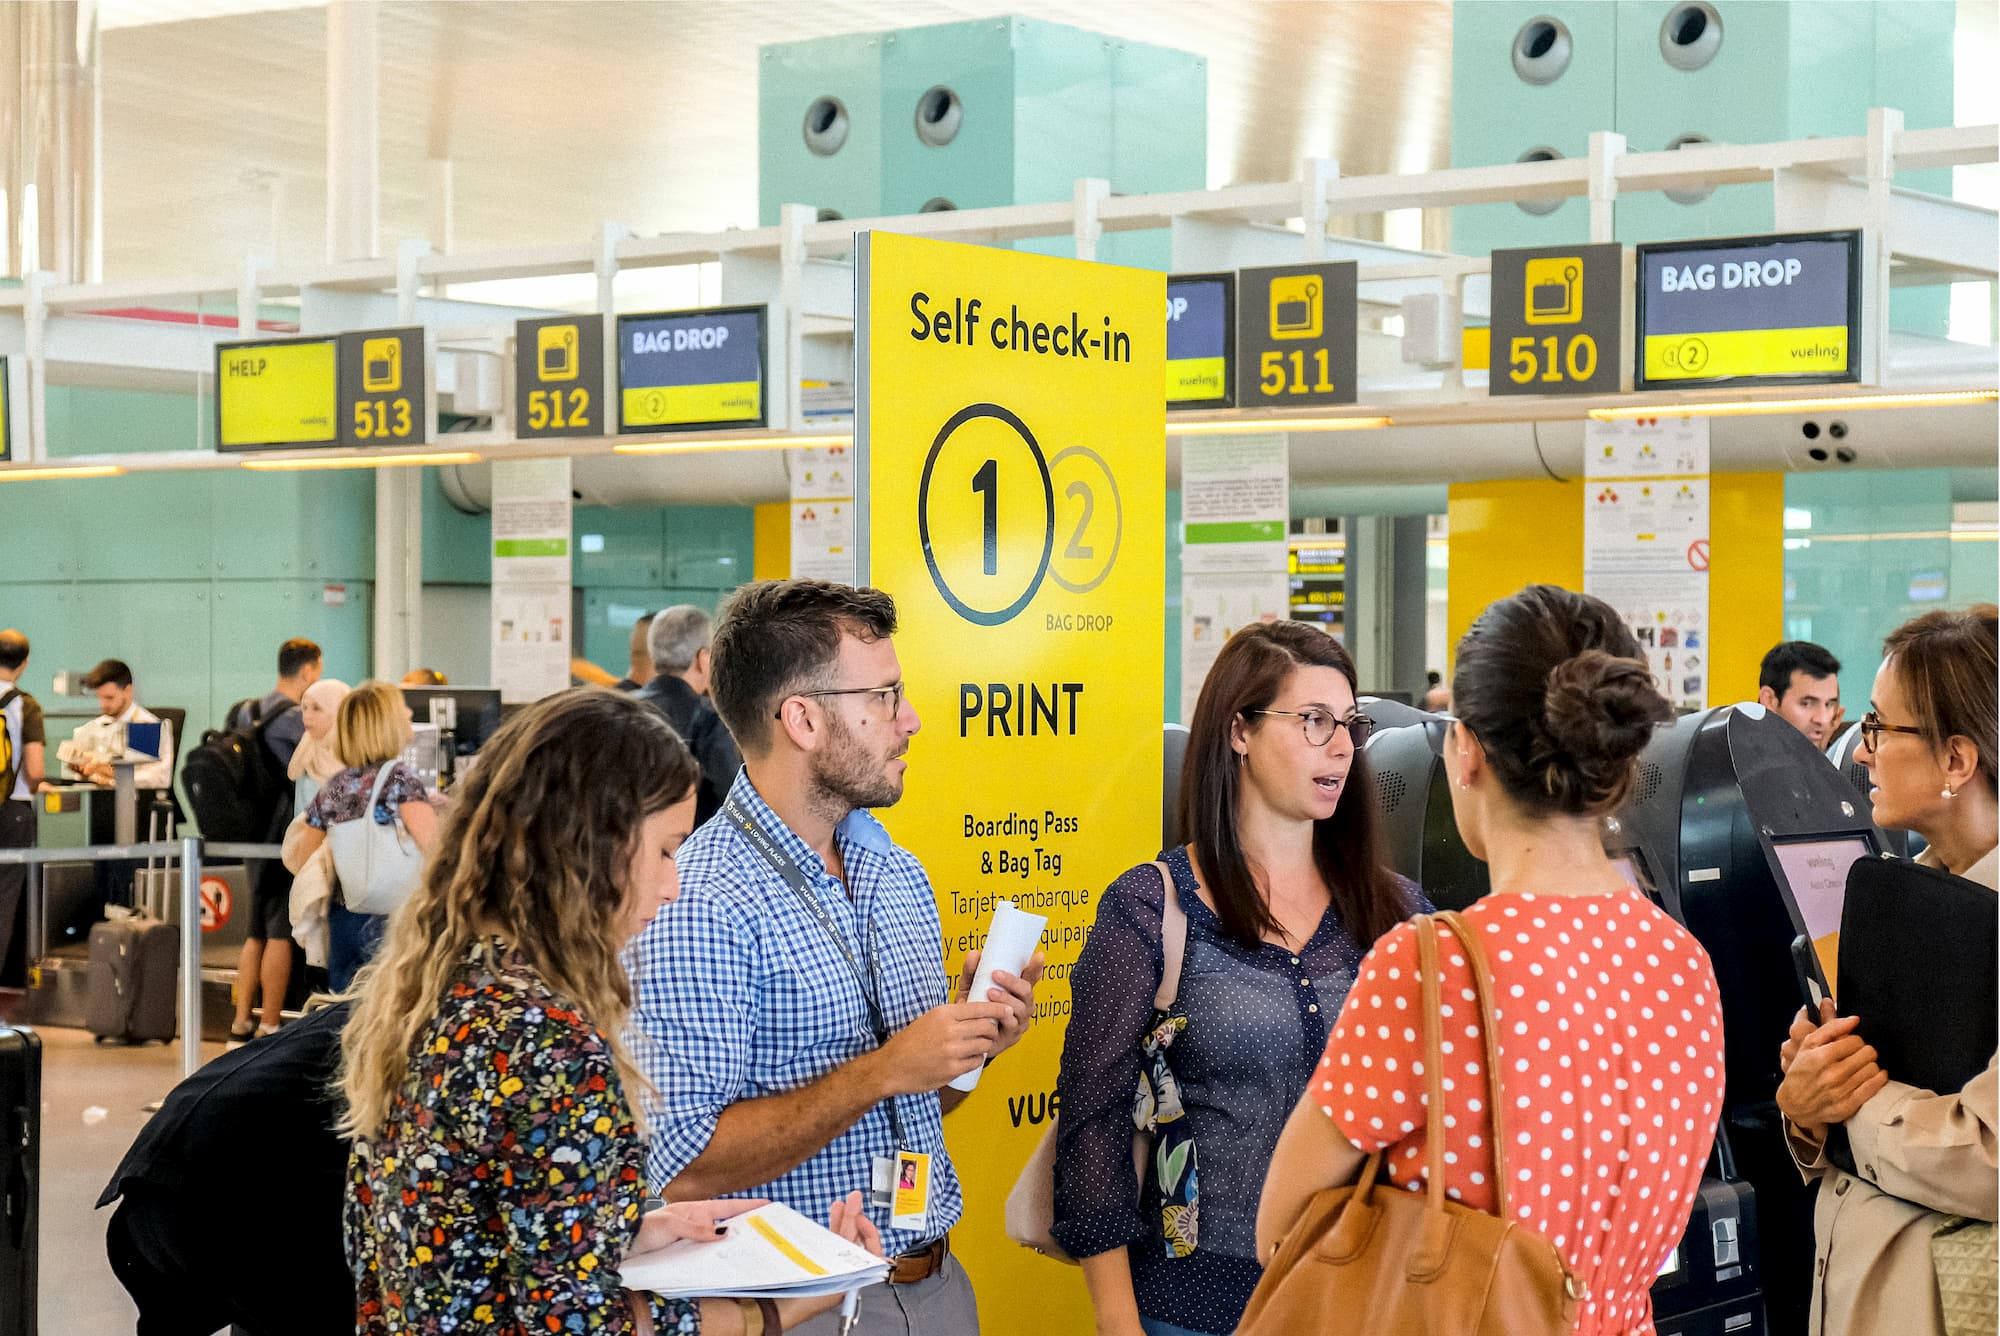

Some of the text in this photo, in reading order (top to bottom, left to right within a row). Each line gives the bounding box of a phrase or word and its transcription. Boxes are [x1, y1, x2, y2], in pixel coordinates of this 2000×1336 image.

[1660, 257, 1803, 294] BAG DROP
[633, 326, 729, 354] BAG DROP
[910, 291, 982, 347] Self
[990, 303, 1131, 364] check-in
[229, 359, 267, 377] HELP
[1508, 333, 1598, 385] 510
[1790, 344, 1840, 360] vueling
[1260, 348, 1334, 396] 511
[354, 397, 412, 439] 513
[528, 387, 590, 430] 512
[972, 459, 1095, 576] 1 2
[1045, 613, 1114, 634] BAG DROP
[960, 683, 1083, 736] PRINT
[731, 809, 746, 824] YEARS
[750, 828, 770, 850] LOVING
[767, 847, 787, 867] PLACES
[964, 810, 1078, 842] Boarding Pass
[981, 848, 1062, 878] & Bag Tag
[799, 885, 826, 919] vueling
[1011, 885, 1089, 913] embarque
[944, 937, 954, 960] y
